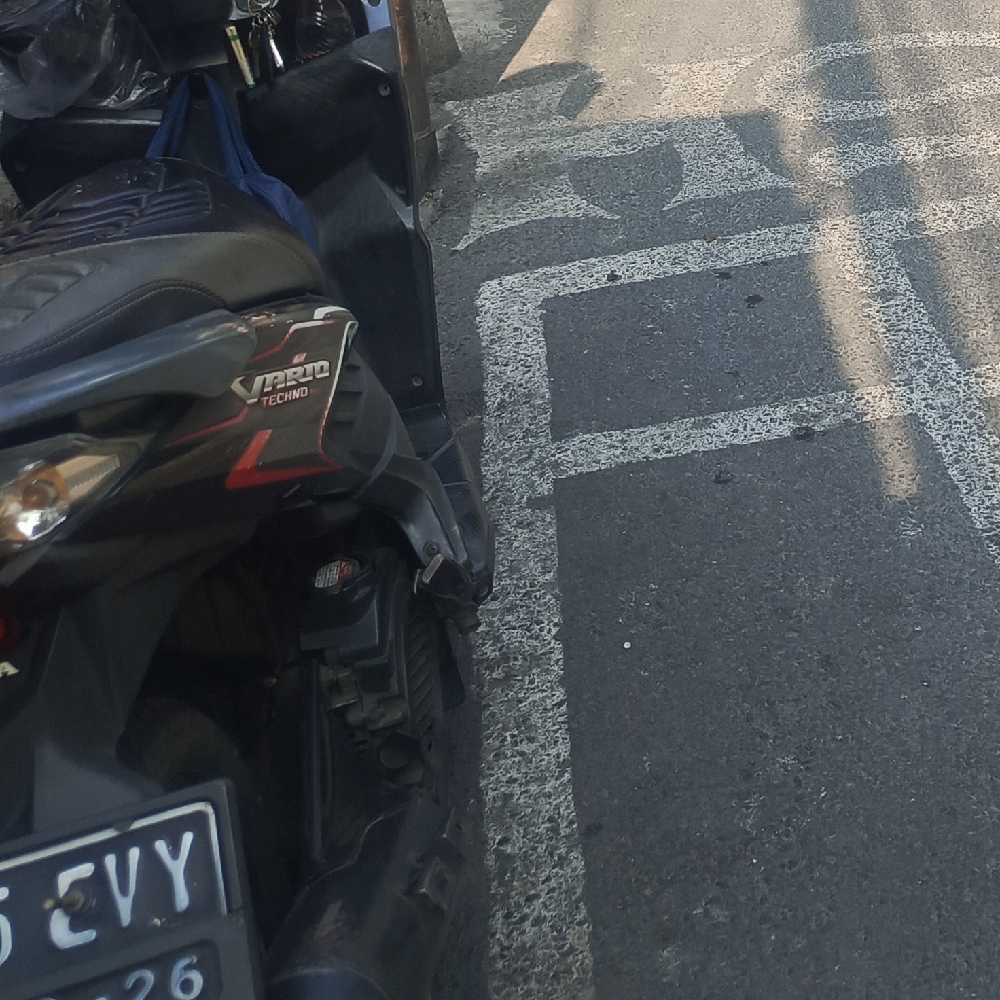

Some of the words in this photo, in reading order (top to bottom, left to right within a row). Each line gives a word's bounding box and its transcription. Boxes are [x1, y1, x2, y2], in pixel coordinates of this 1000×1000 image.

[230, 360, 330, 405] VARIO
[261, 386, 309, 408] TECHNO
[50, 831, 194, 950] EVY
